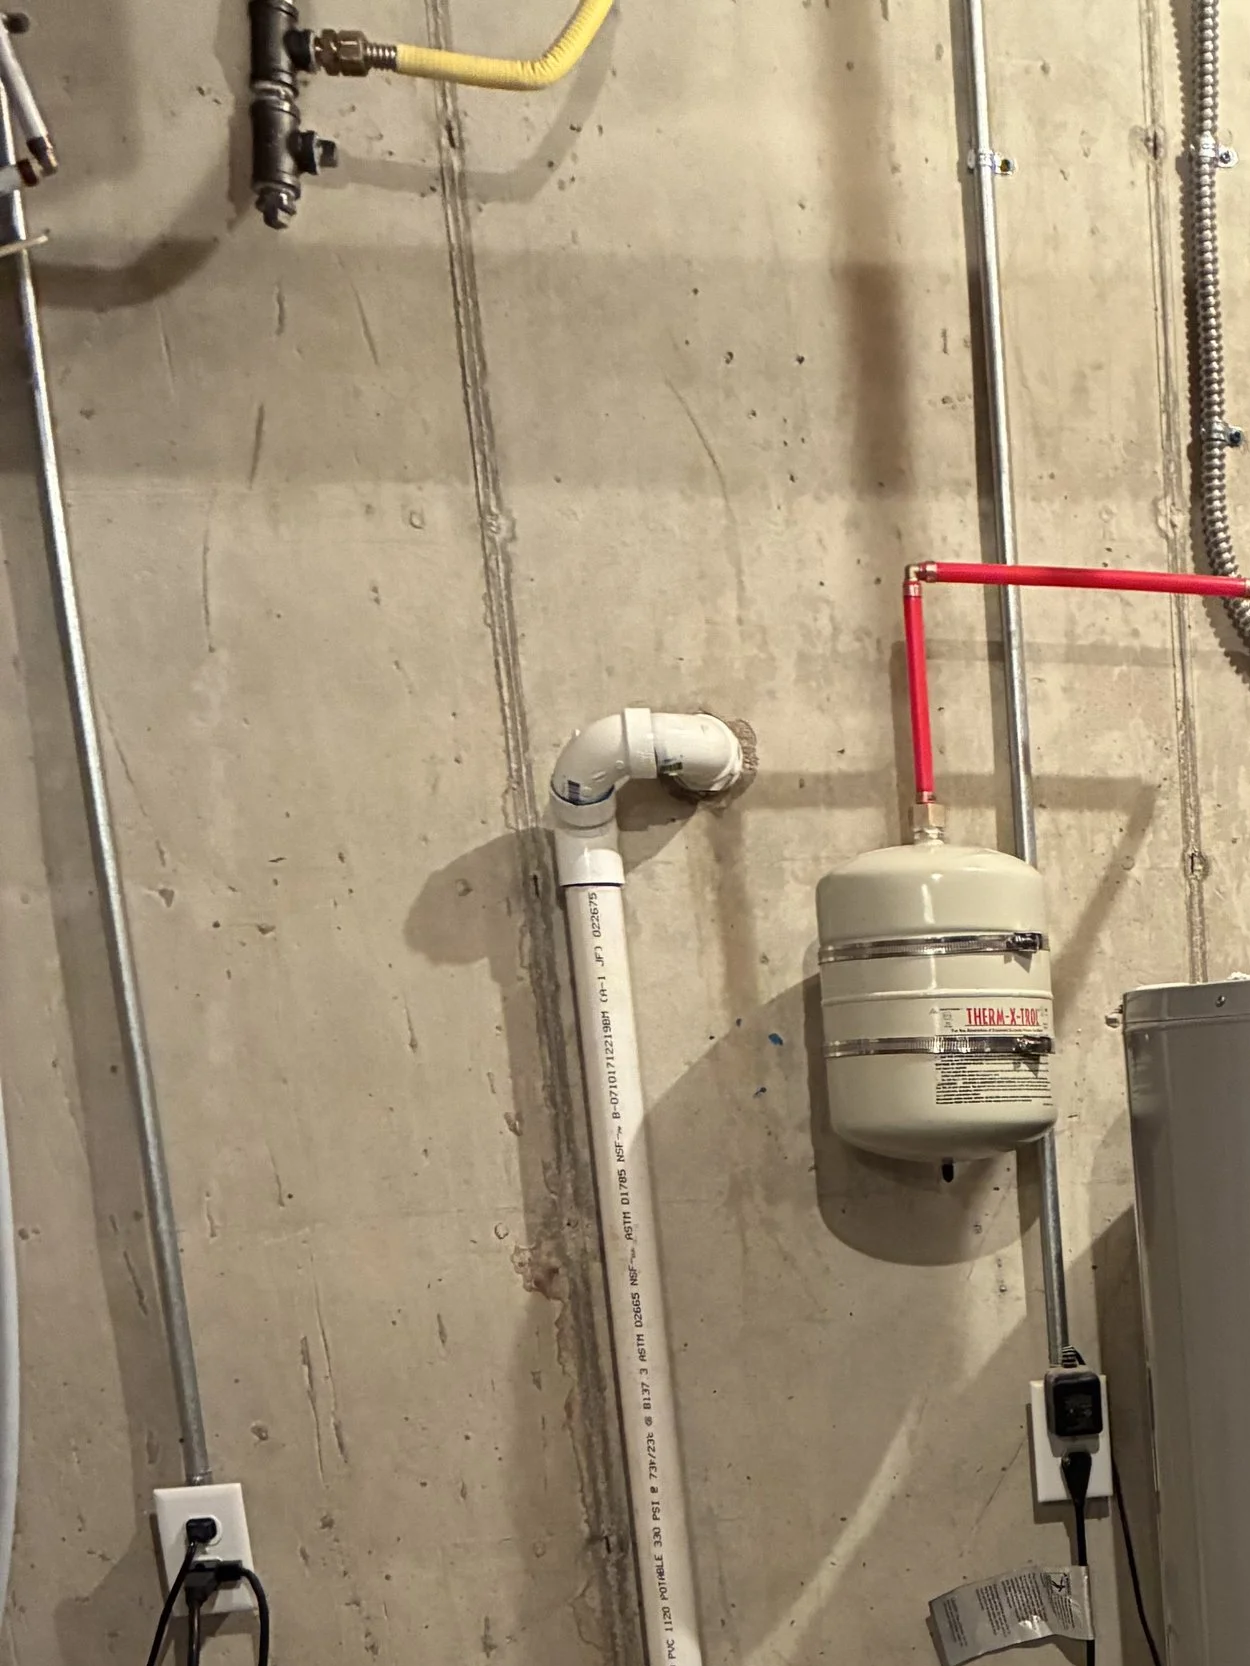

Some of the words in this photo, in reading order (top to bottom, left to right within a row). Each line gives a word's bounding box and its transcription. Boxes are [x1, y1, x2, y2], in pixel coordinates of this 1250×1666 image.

[596, 975, 608, 1002] (A-1
[617, 1168, 629, 1204] D1785
[621, 1210, 633, 1240] ASTM
[630, 1292, 643, 1327] D2665
[634, 1334, 647, 1362] ASTM
[650, 1500, 662, 1520] PSI
[651, 1526, 663, 1547] 330
[654, 1553, 669, 1600] POTABLE
[661, 1606, 673, 1632] 1120
[665, 1638, 676, 1658] PVC
